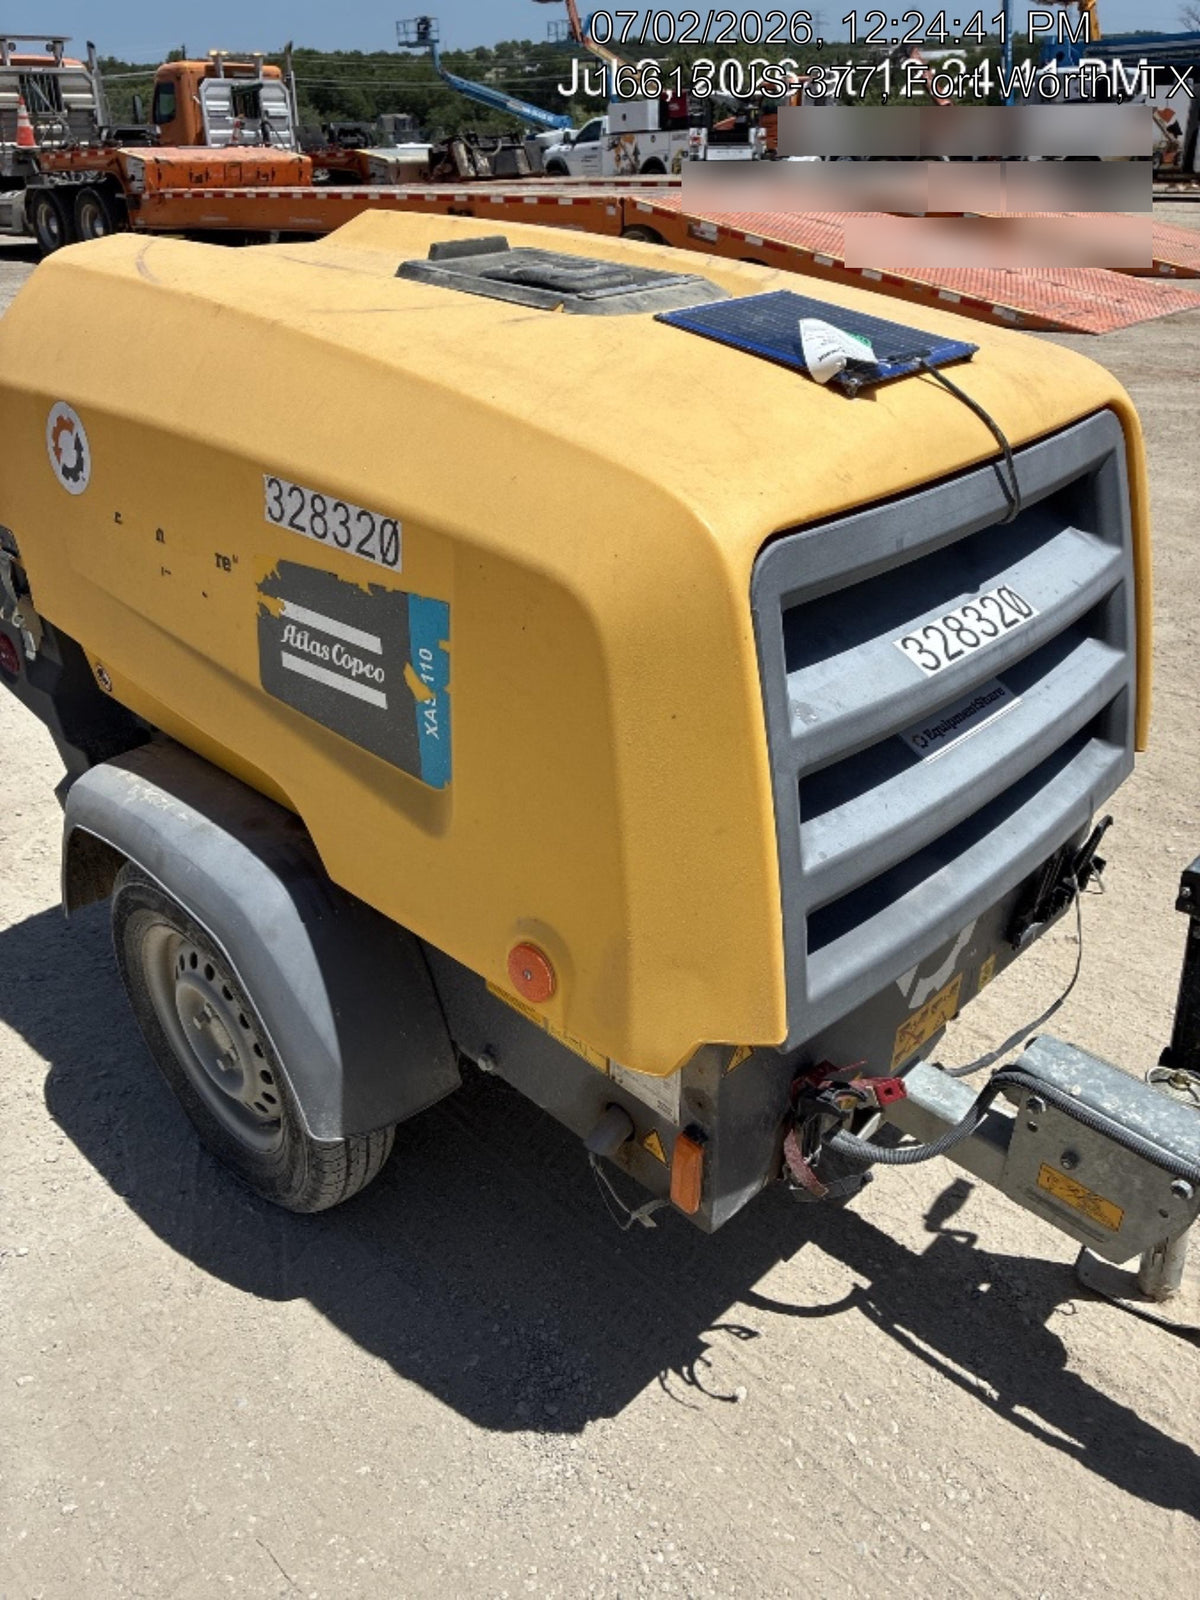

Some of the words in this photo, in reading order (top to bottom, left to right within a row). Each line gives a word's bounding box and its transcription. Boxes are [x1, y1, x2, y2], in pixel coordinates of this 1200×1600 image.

[267, 477, 400, 567] 328320
[281, 623, 330, 661] Atlas
[331, 643, 385, 683] Copco
[901, 586, 1033, 671] 328320
[419, 648, 434, 683] 110
[922, 686, 1006, 743] EquipmentShare
